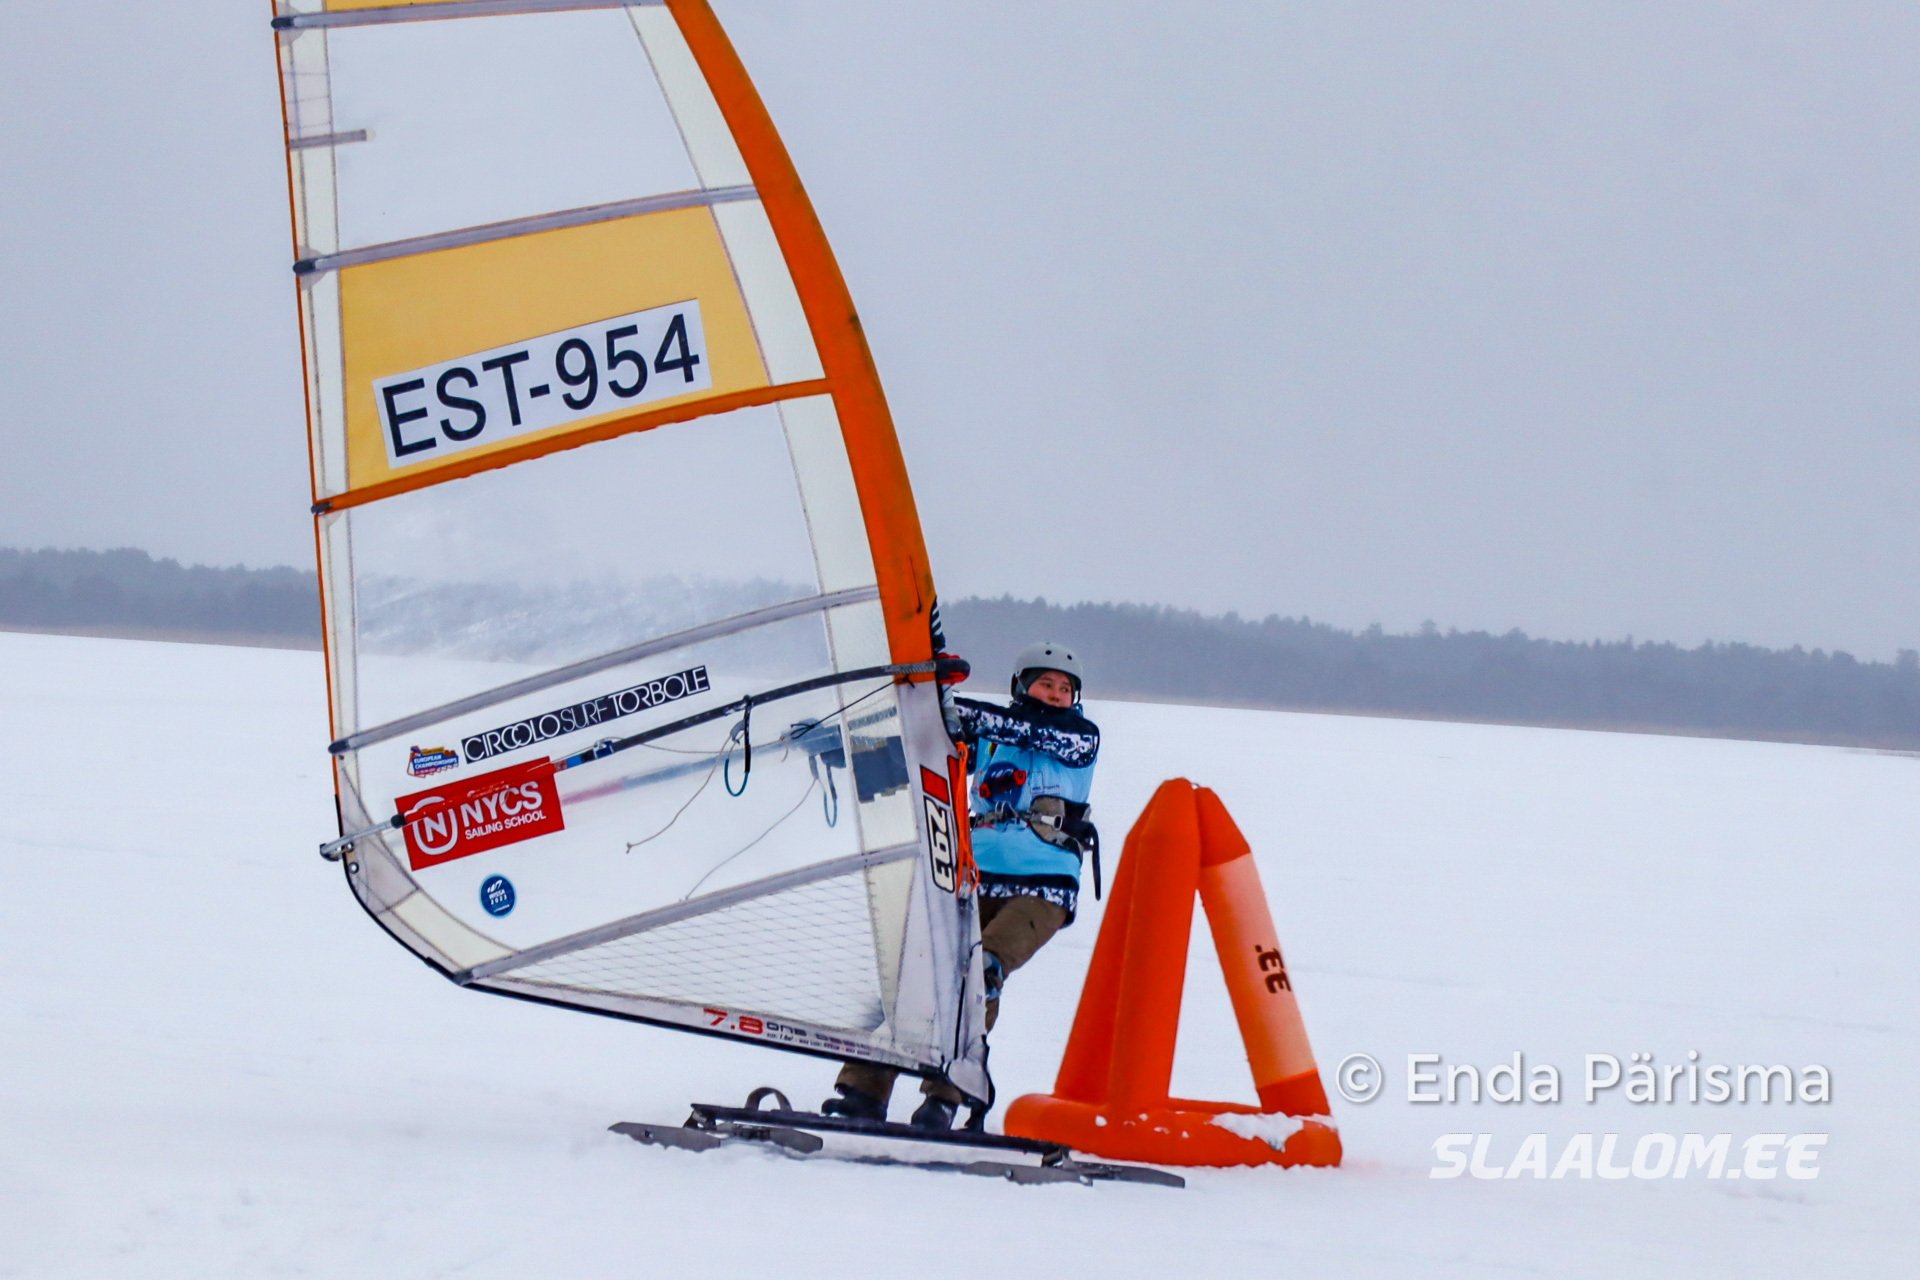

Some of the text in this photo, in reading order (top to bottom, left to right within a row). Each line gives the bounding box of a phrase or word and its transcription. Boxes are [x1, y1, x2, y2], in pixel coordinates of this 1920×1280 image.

[382, 313, 700, 458] EST-954
[460, 781, 543, 828] NYCS
[464, 811, 547, 841] SAILING SCHOOL
[703, 1008, 764, 1035] 7.8
